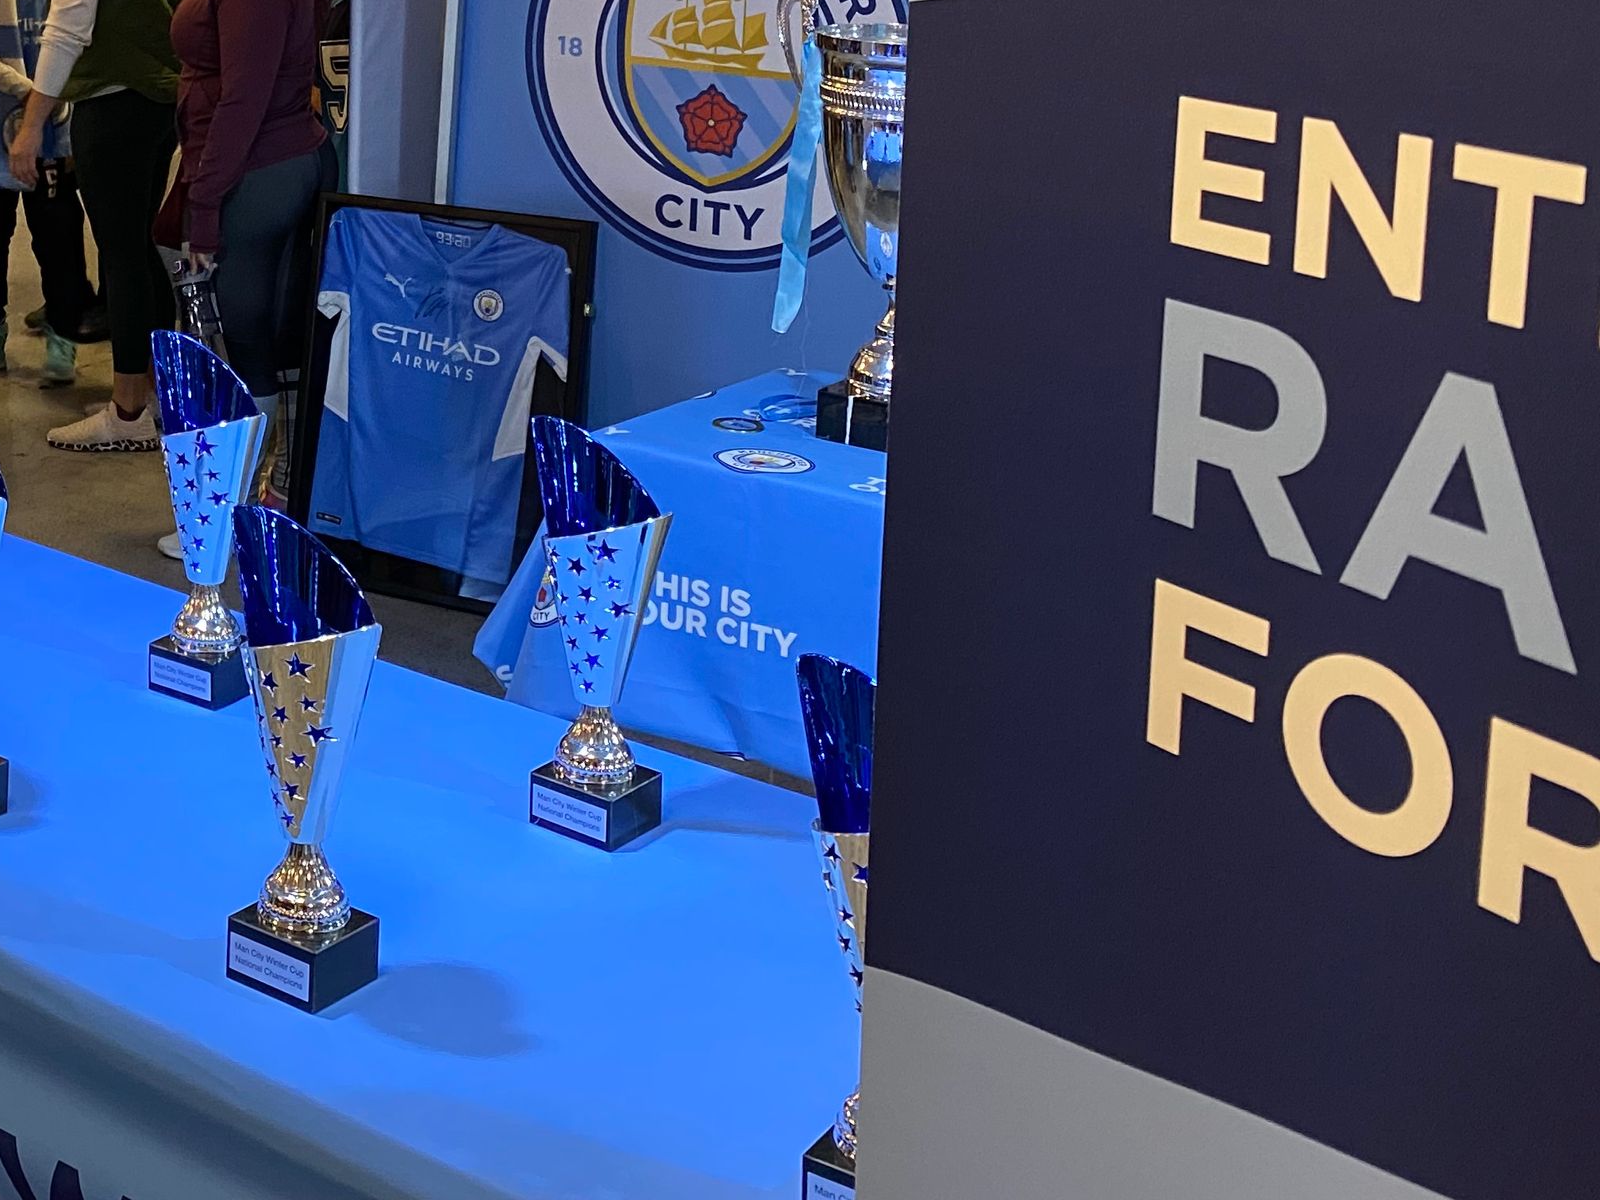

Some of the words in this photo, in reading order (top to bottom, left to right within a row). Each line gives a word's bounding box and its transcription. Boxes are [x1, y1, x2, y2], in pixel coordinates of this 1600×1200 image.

[557, 35, 583, 57] 18
[655, 193, 766, 240] CITY
[1169, 95, 1600, 340] ENT
[372, 322, 500, 366] ETIHAD
[392, 351, 475, 381] AIRWAYS
[654, 571, 711, 609] HIS
[720, 585, 751, 617] IS
[716, 616, 798, 659] CITY
